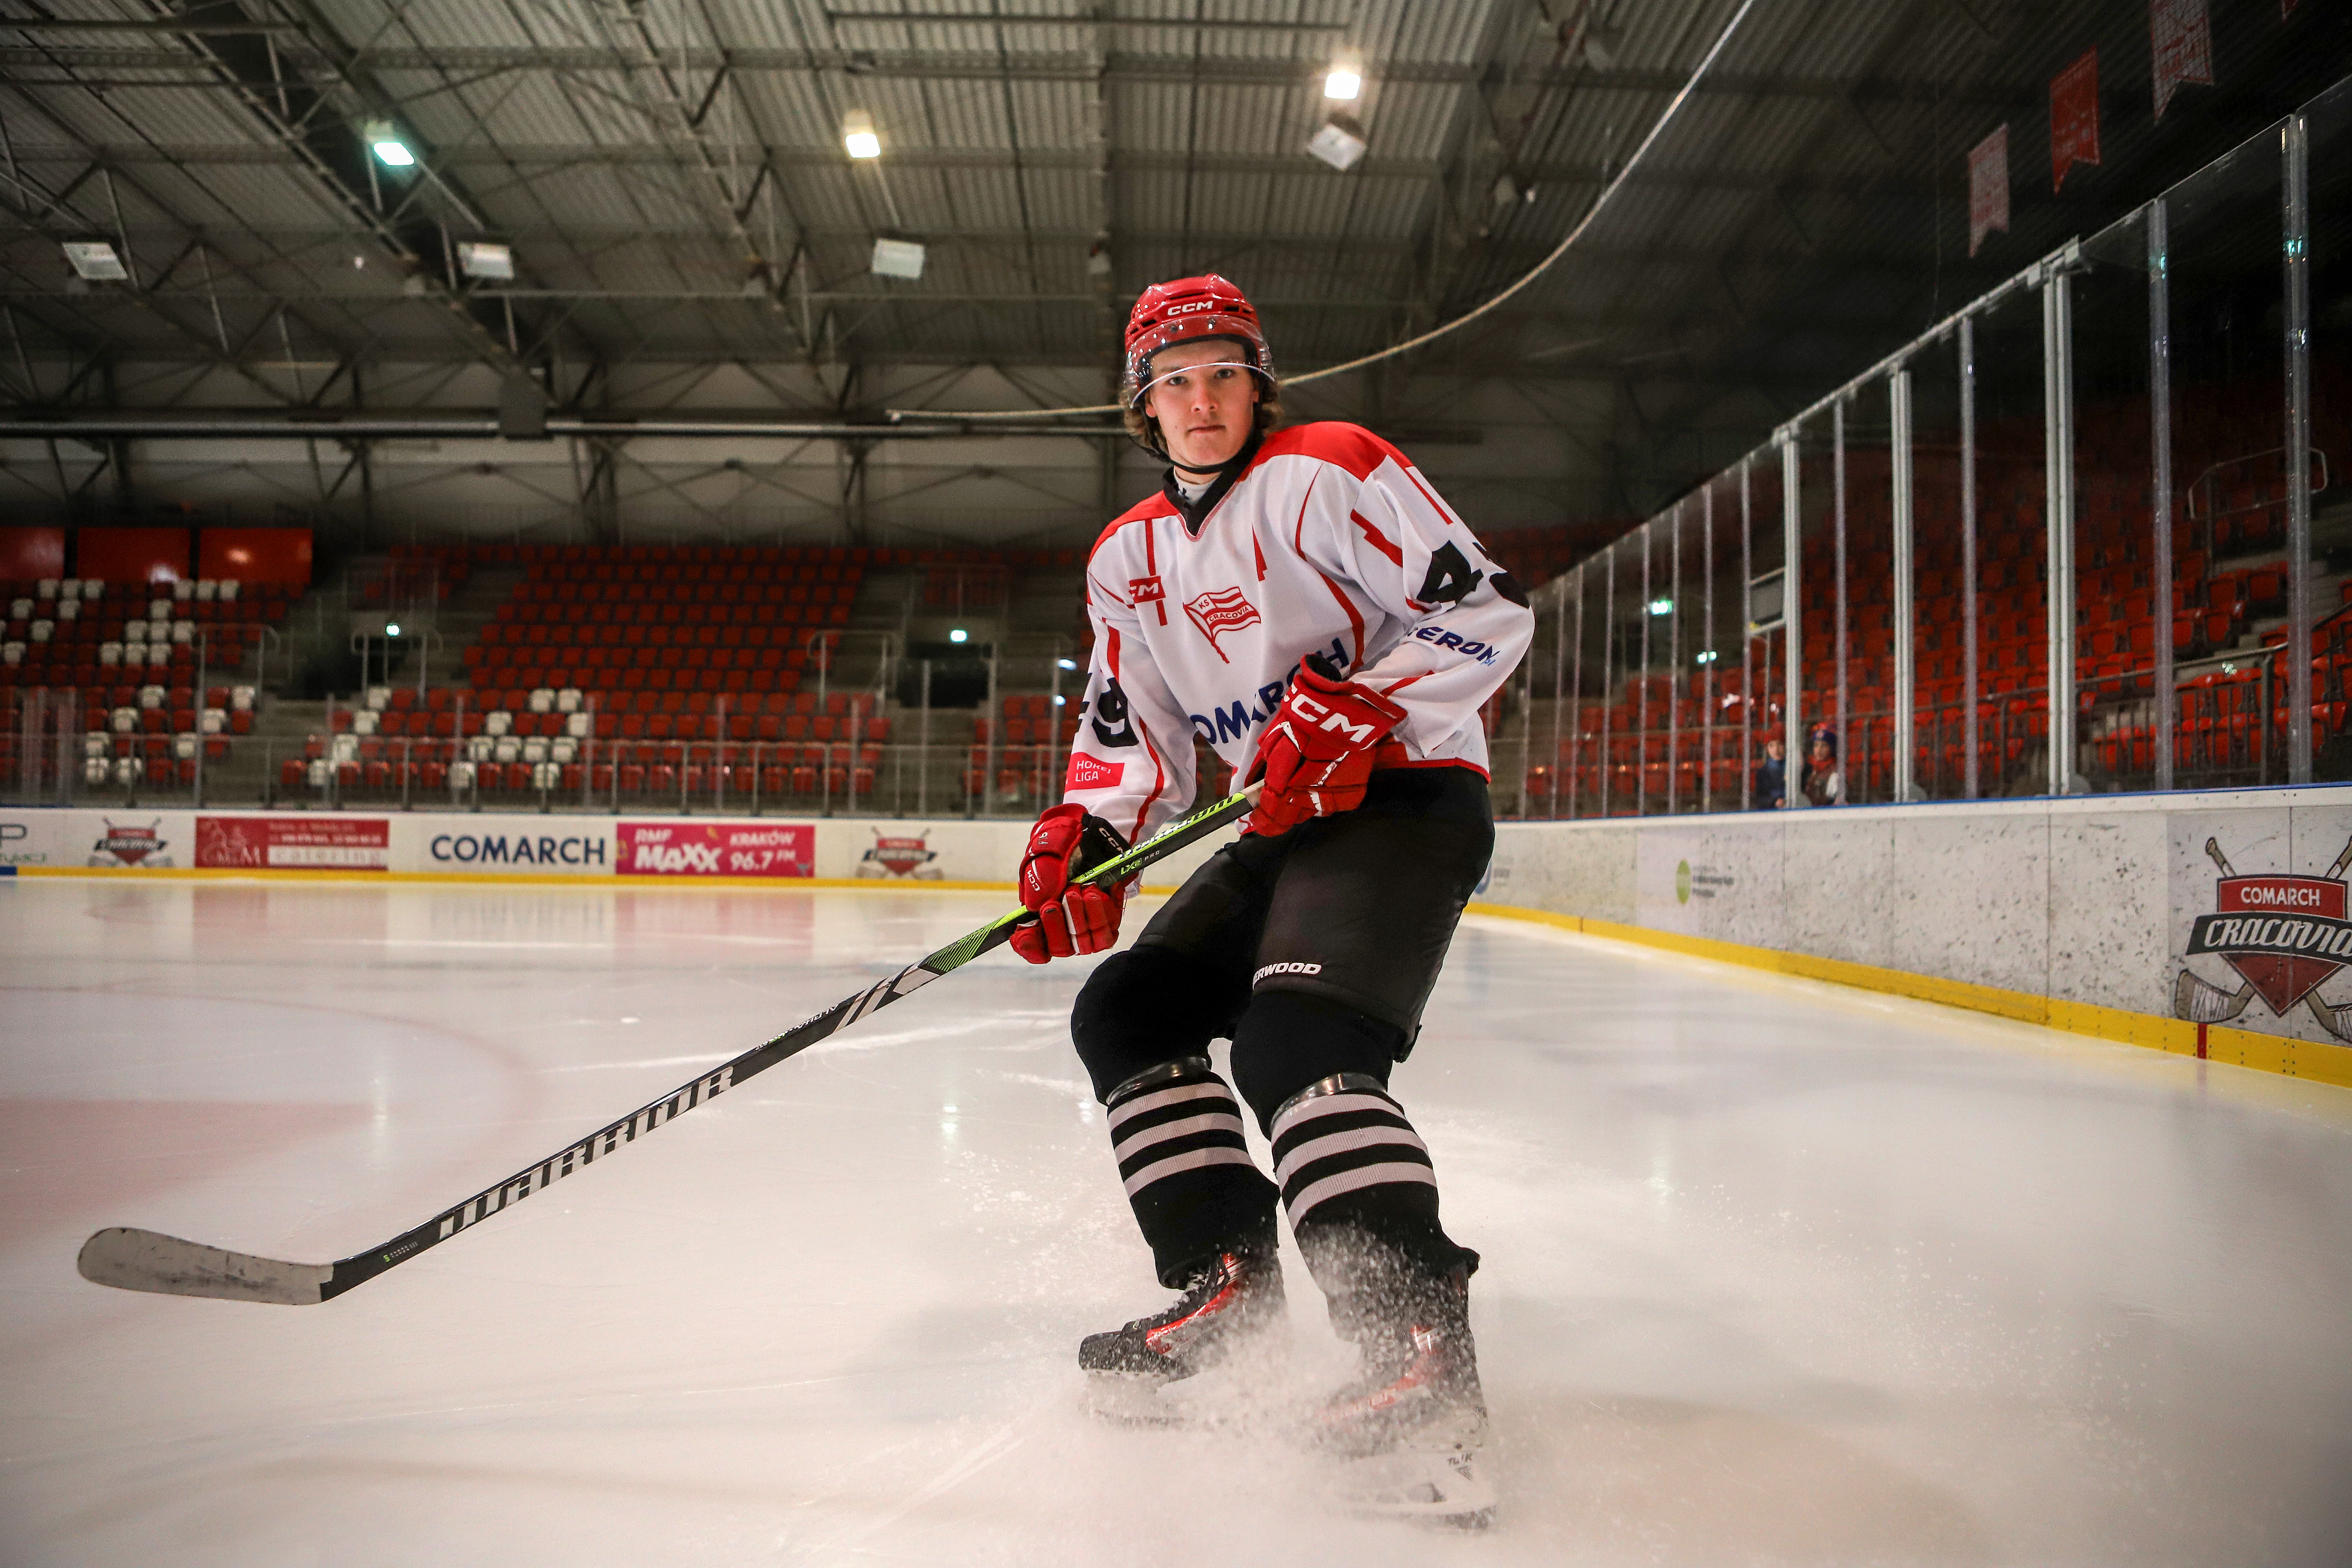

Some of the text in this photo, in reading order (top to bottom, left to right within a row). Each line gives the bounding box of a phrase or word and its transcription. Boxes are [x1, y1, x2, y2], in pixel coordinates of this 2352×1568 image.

[1167, 301, 1213, 316] CCM
[1198, 599, 1210, 609] KS
[1209, 606, 1249, 622] CRACOVIA
[1408, 626, 1500, 661] ERON
[1078, 677, 1140, 748] 9
[1076, 760, 1112, 774] HOKEJ
[1075, 771, 1099, 782] LIGA
[431, 835, 605, 864] COMARCH
[1145, 850, 1160, 861] PRO
[730, 850, 774, 871] 96.7
[1027, 869, 1040, 891] CCM
[2240, 886, 2321, 906] COMARCH
